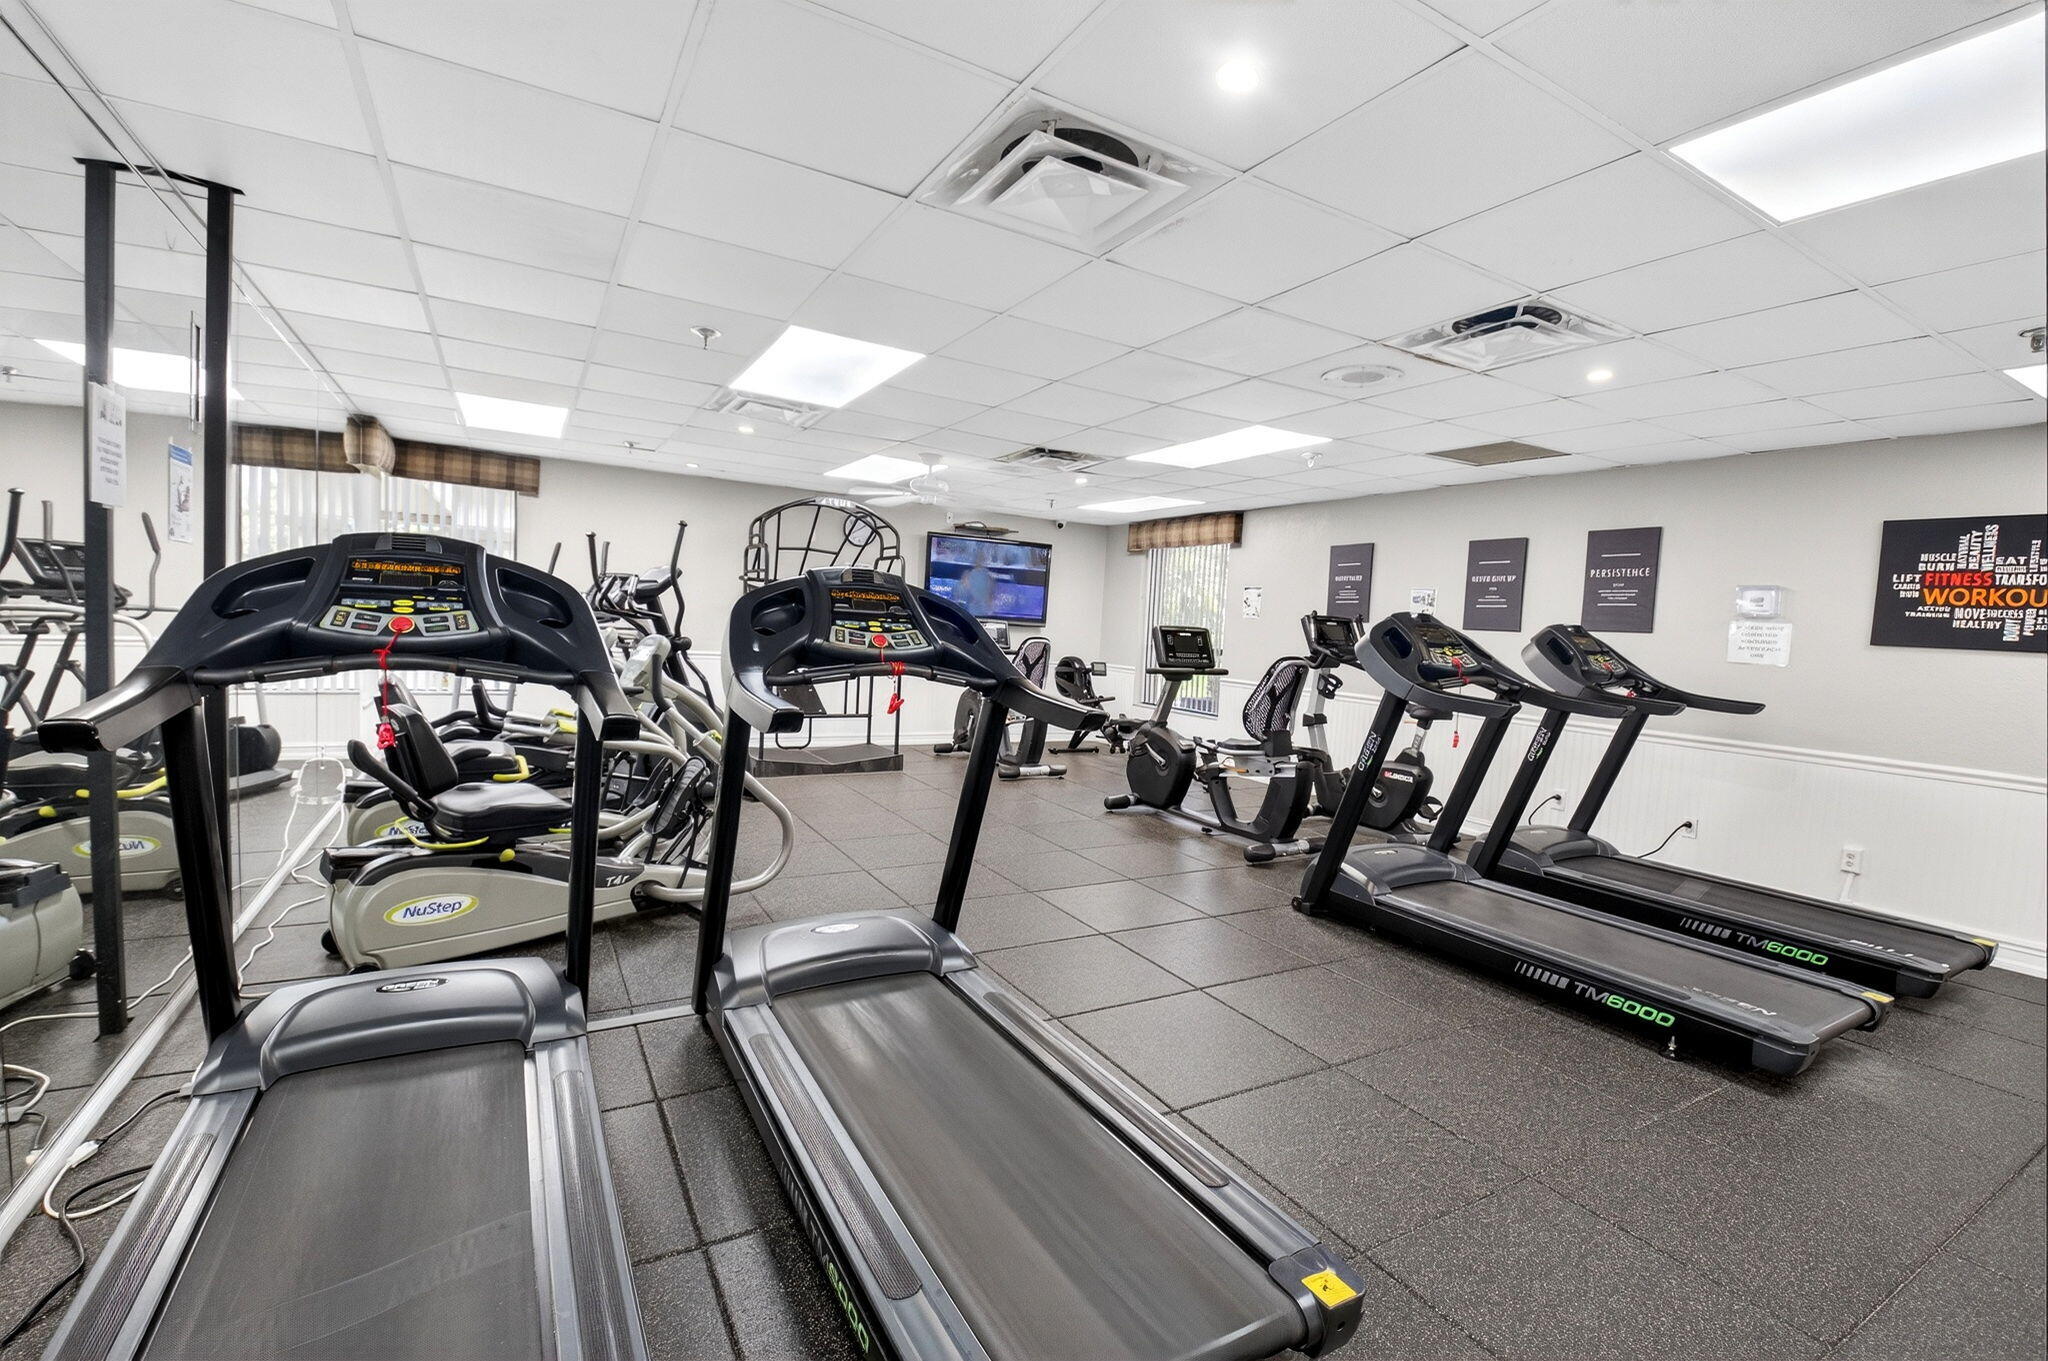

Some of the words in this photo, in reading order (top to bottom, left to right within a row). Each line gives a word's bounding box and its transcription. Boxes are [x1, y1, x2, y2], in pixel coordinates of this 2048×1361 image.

[1920, 553, 1957, 562] MUSCLE
[1590, 567, 1650, 578] PERSISTENCE
[1892, 573, 1922, 583] LIFT
[1924, 571, 1994, 587] FITNESS
[1953, 607, 1987, 620] MOVE
[1952, 619, 2003, 630] HEALTHY
[402, 900, 463, 919] NuStep
[1735, 931, 1829, 966] TM6000
[1573, 981, 1675, 1027] TM6000
